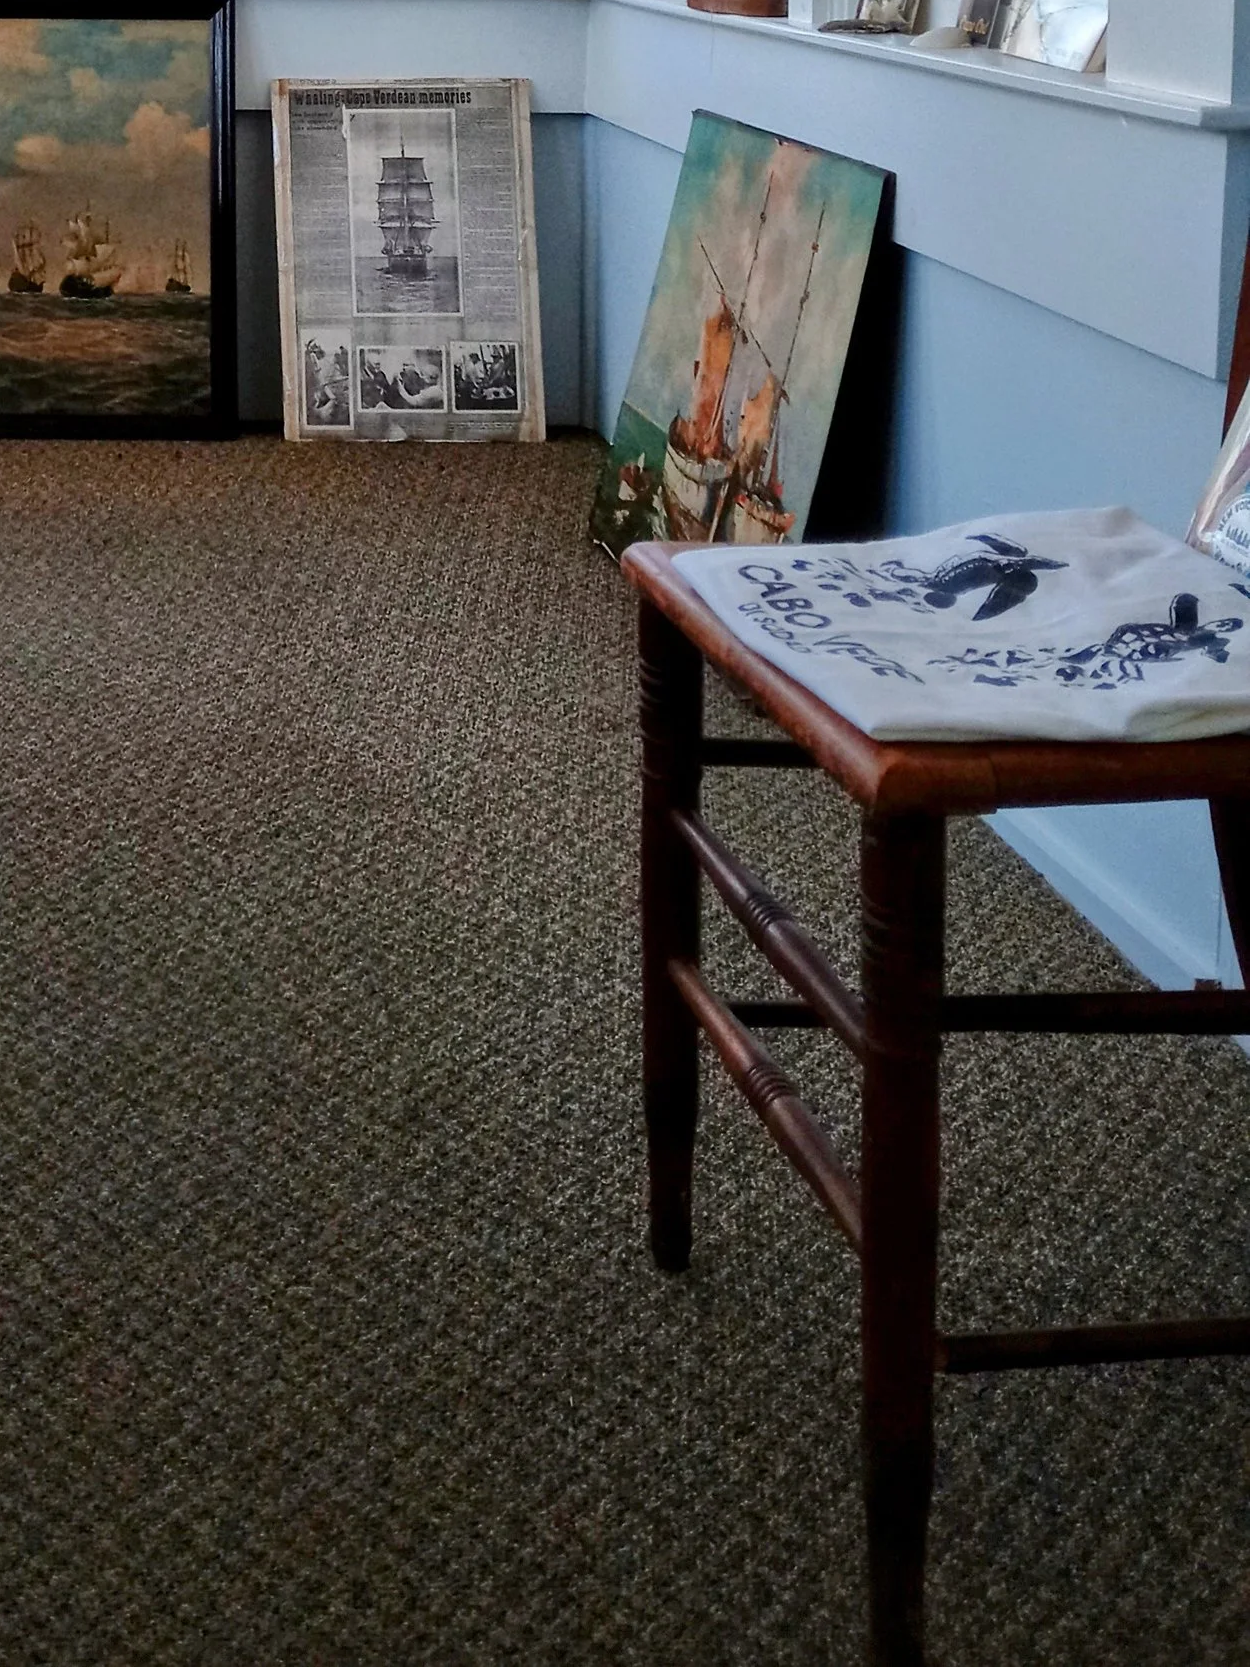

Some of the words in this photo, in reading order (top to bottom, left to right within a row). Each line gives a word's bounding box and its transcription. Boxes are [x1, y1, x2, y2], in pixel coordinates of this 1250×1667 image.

[345, 91, 371, 108] Cape
[373, 89, 416, 104] Verdean
[418, 90, 472, 104] memories
[738, 565, 832, 628] CABO
